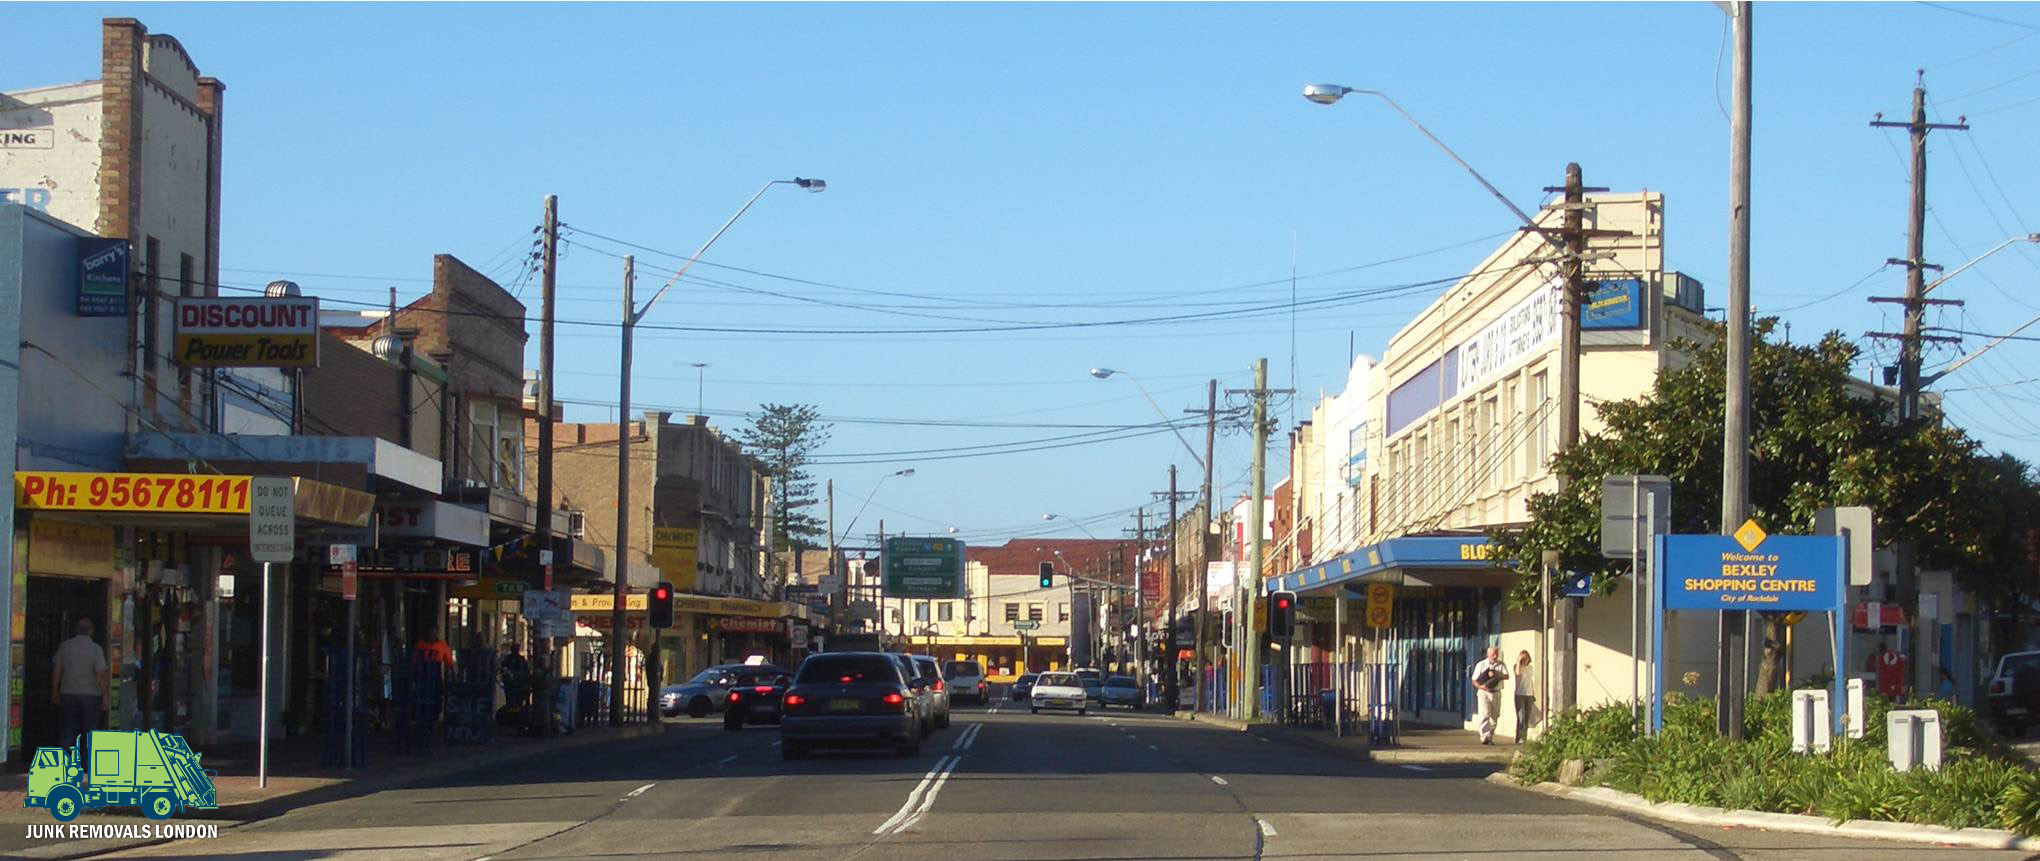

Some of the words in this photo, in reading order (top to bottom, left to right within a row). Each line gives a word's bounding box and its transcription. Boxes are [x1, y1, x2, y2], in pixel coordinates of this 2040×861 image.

[182, 305, 311, 328] DISCOUNT
[185, 338, 253, 361] Power
[256, 338, 309, 361] Tools
[22, 476, 77, 506] Ph:
[89, 477, 249, 510] 95678111
[257, 486, 270, 497] DO
[272, 487, 289, 498] NOT
[258, 505, 288, 517] QUEUE
[257, 524, 289, 536] ACROSS
[656, 531, 696, 544] CHEMIST
[1721, 552, 1765, 562] Welcome
[1767, 554, 1779, 562] to
[1722, 564, 1778, 577] BEXLEY
[1684, 578, 1757, 592] SHOPPING
[1760, 579, 1816, 592] CENTRE
[1720, 594, 1736, 604] City
[1737, 594, 1747, 603] of
[719, 617, 776, 631] Chemist
